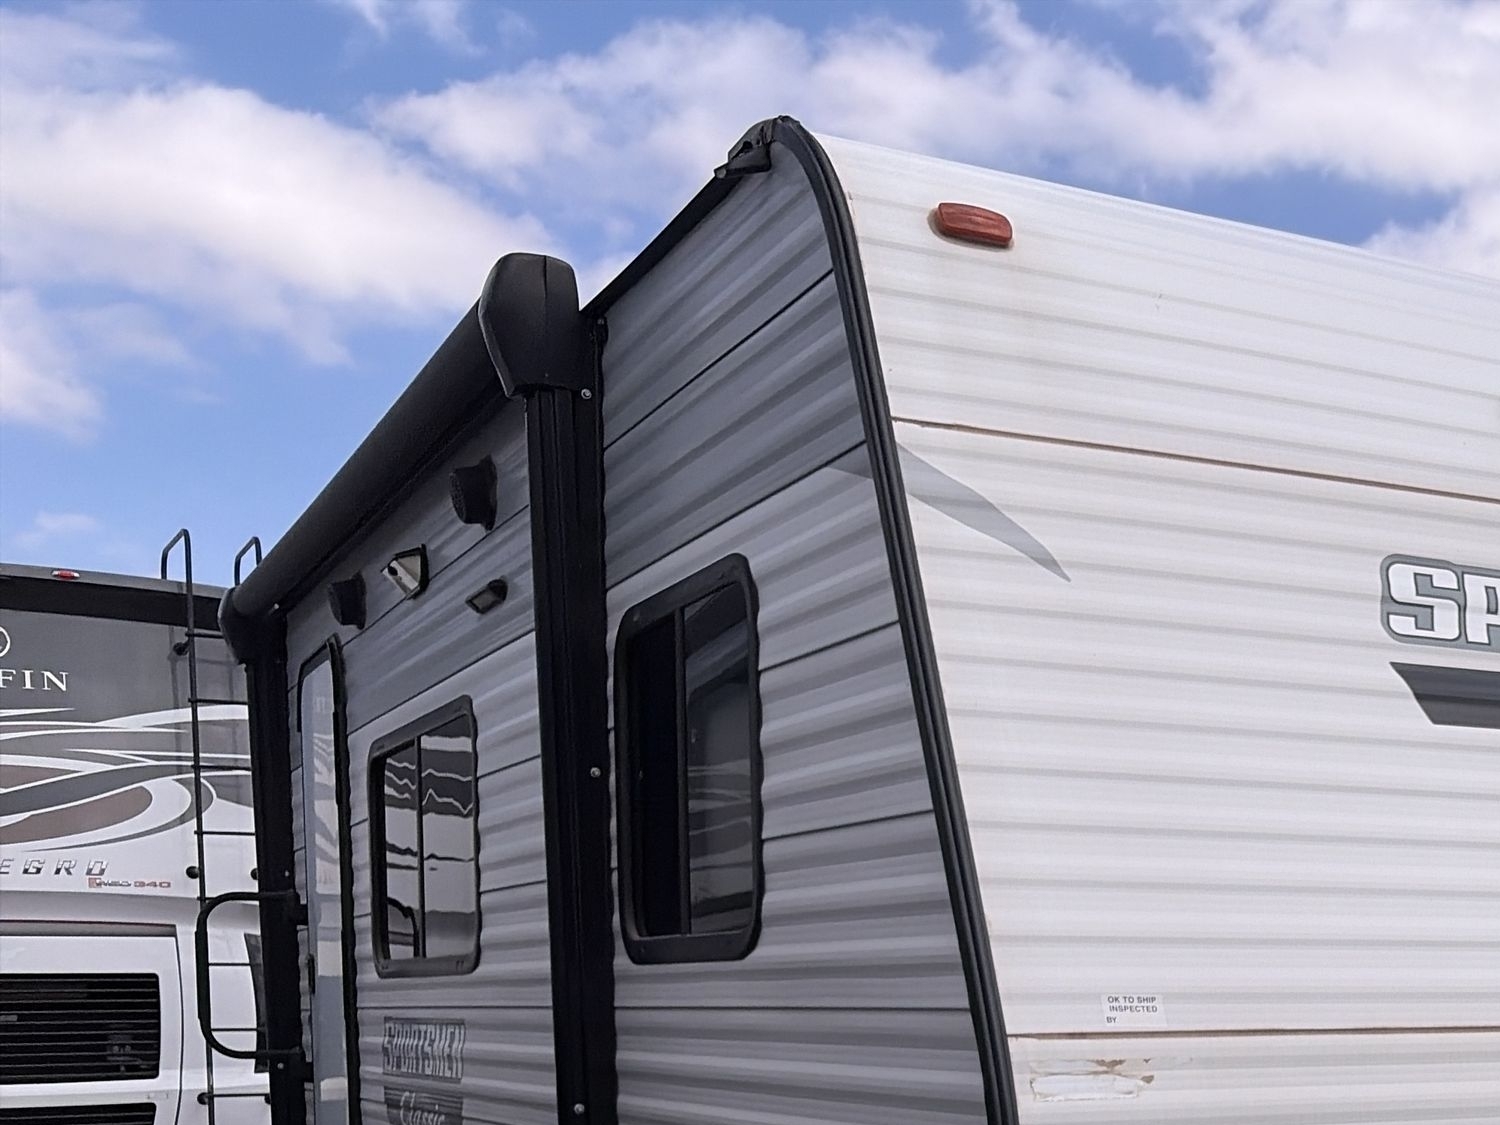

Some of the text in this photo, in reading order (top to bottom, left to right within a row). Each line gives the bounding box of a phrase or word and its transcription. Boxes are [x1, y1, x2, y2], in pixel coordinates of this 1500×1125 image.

[0, 669, 69, 692] FIN
[1107, 995, 1157, 1004] OK TO SHIP
[1109, 1005, 1158, 1013] INSPECTED
[1106, 1016, 1117, 1024] BY
[384, 1022, 465, 1080] SPORTSMEN
